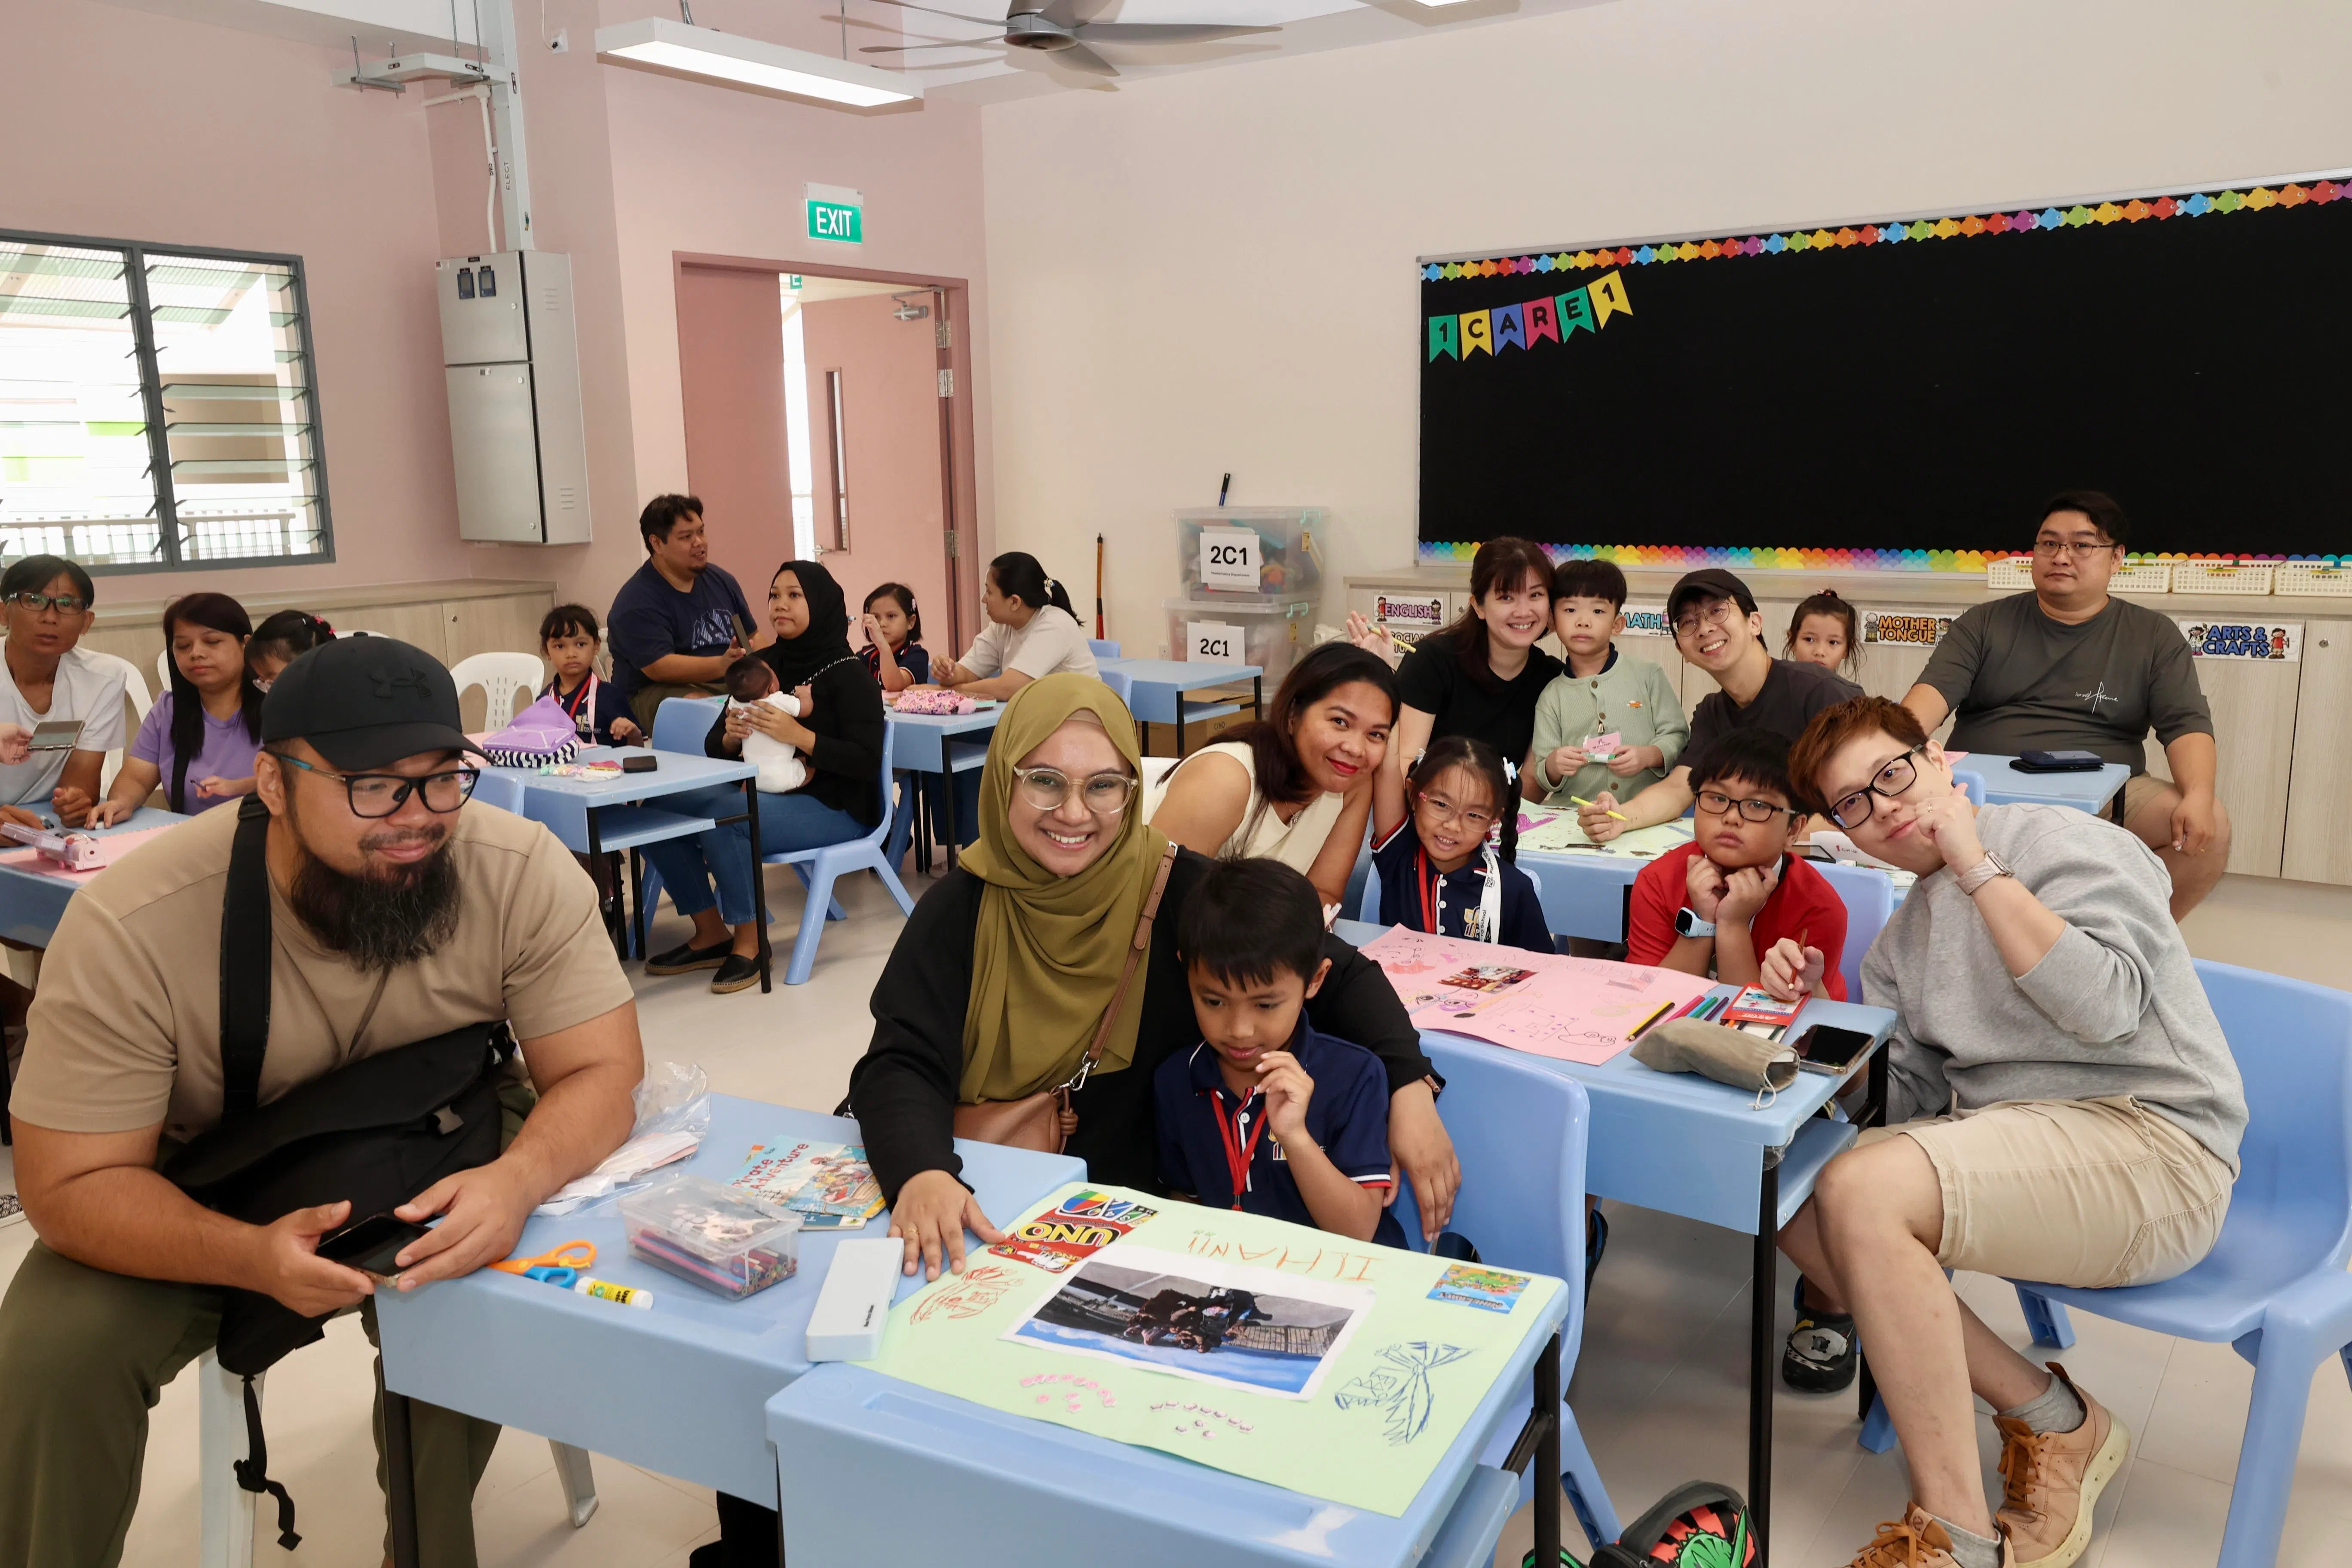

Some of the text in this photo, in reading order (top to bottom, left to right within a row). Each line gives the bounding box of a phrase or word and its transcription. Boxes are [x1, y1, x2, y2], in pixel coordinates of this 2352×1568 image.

[816, 206, 852, 237] EXIT
[1211, 545, 1247, 566] 2C1
[1384, 603, 1432, 619] ENGLISH
[1878, 616, 1937, 631] MOTHER
[1878, 628, 1936, 643] TONGUE
[2205, 625, 2268, 641] ARTS &
[1200, 638, 1230, 657] 2C1
[2202, 640, 2270, 656] CRAFTS
[750, 1143, 809, 1190] Adventure
[1016, 1222, 1118, 1246] UNO
